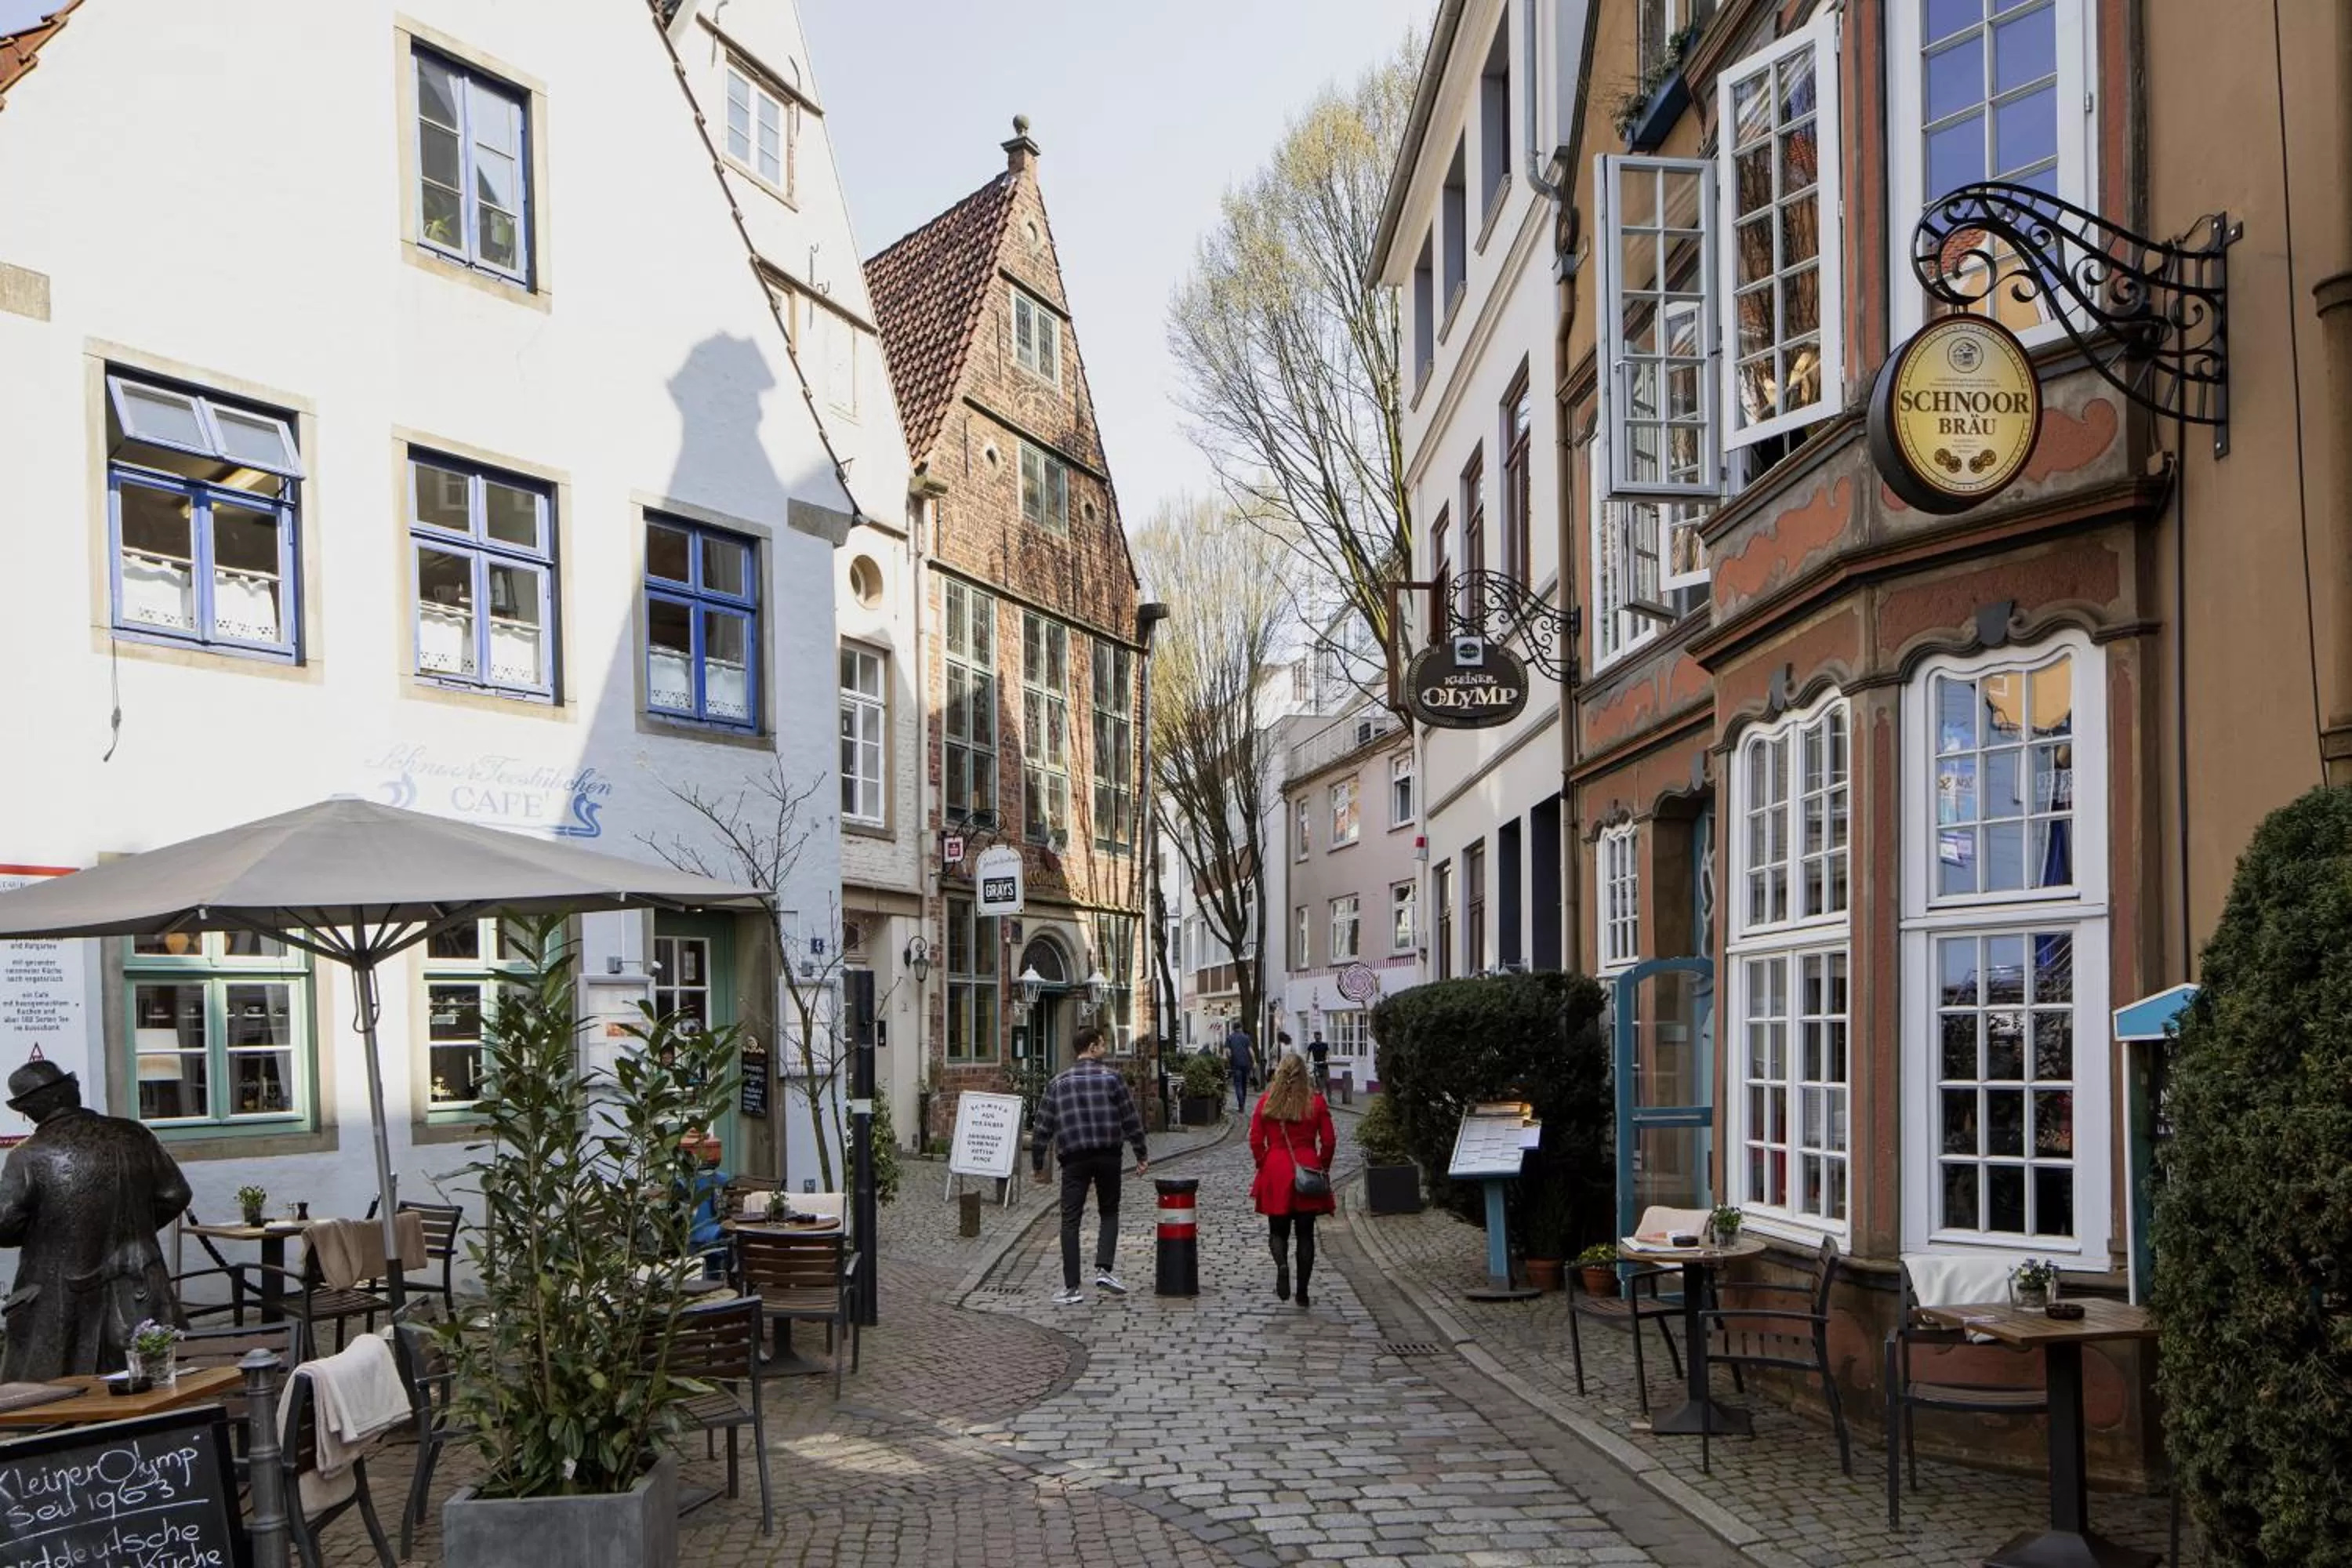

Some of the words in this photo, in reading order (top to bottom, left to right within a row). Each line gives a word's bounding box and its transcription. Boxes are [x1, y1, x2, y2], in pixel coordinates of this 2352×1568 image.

[1900, 390, 2030, 414] SCHNOOR
[1938, 414, 1996, 435] BRÄU
[985, 882, 1014, 898] GRAYS
